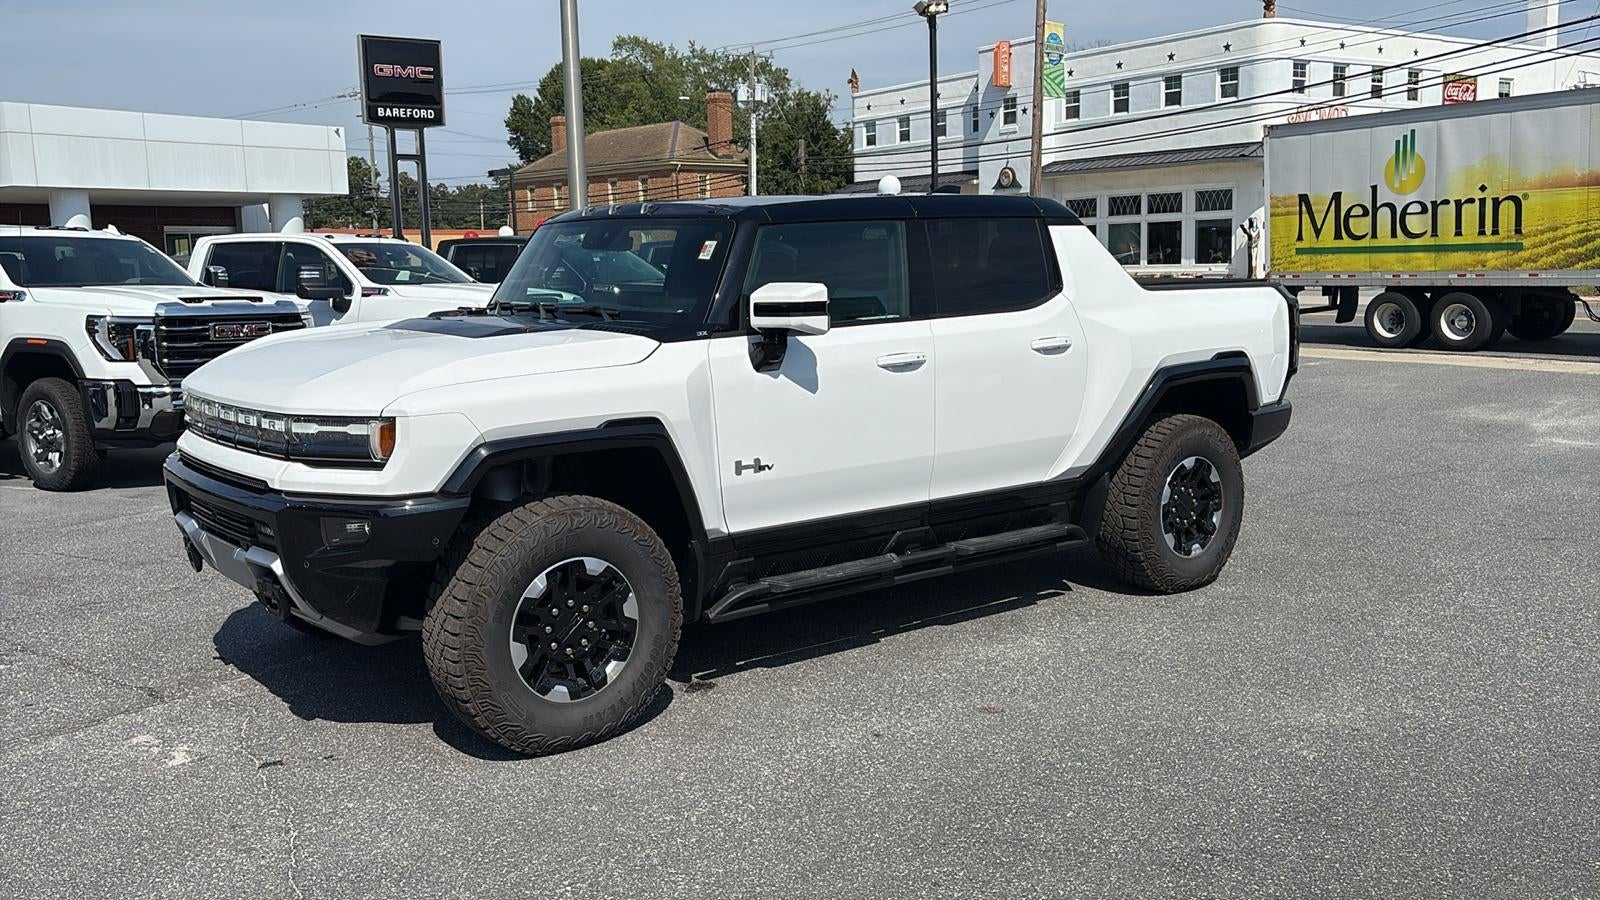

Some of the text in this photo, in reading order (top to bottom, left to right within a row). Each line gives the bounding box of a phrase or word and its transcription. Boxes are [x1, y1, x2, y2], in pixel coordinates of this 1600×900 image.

[373, 63, 434, 79] GMC
[377, 107, 435, 119] BAREFORD
[1296, 183, 1524, 242] Meherrin
[214, 324, 269, 338] GMC
